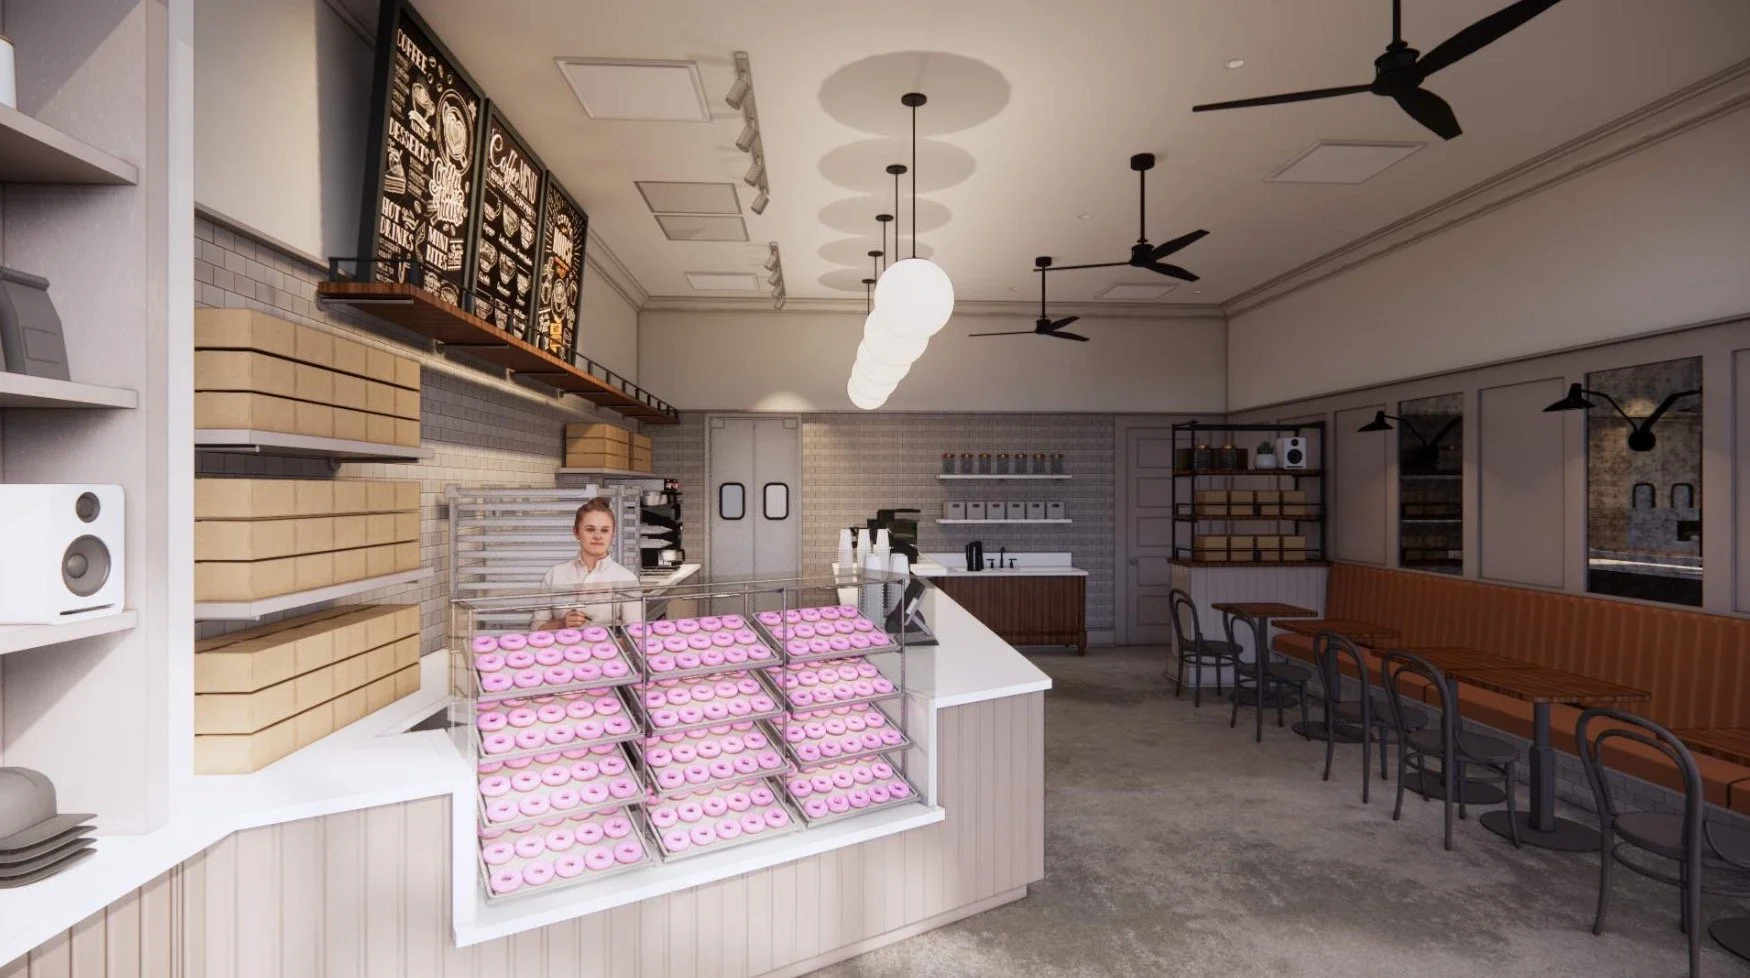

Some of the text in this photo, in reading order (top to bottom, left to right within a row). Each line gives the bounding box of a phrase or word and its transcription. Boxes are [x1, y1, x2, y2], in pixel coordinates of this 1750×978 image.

[397, 28, 427, 75] COFFEE
[389, 117, 430, 166] DESSERTS
[489, 132, 521, 190] Coffee
[382, 196, 401, 224] HOT
[379, 215, 414, 252] DRINKS
[427, 225, 449, 254] MINI
